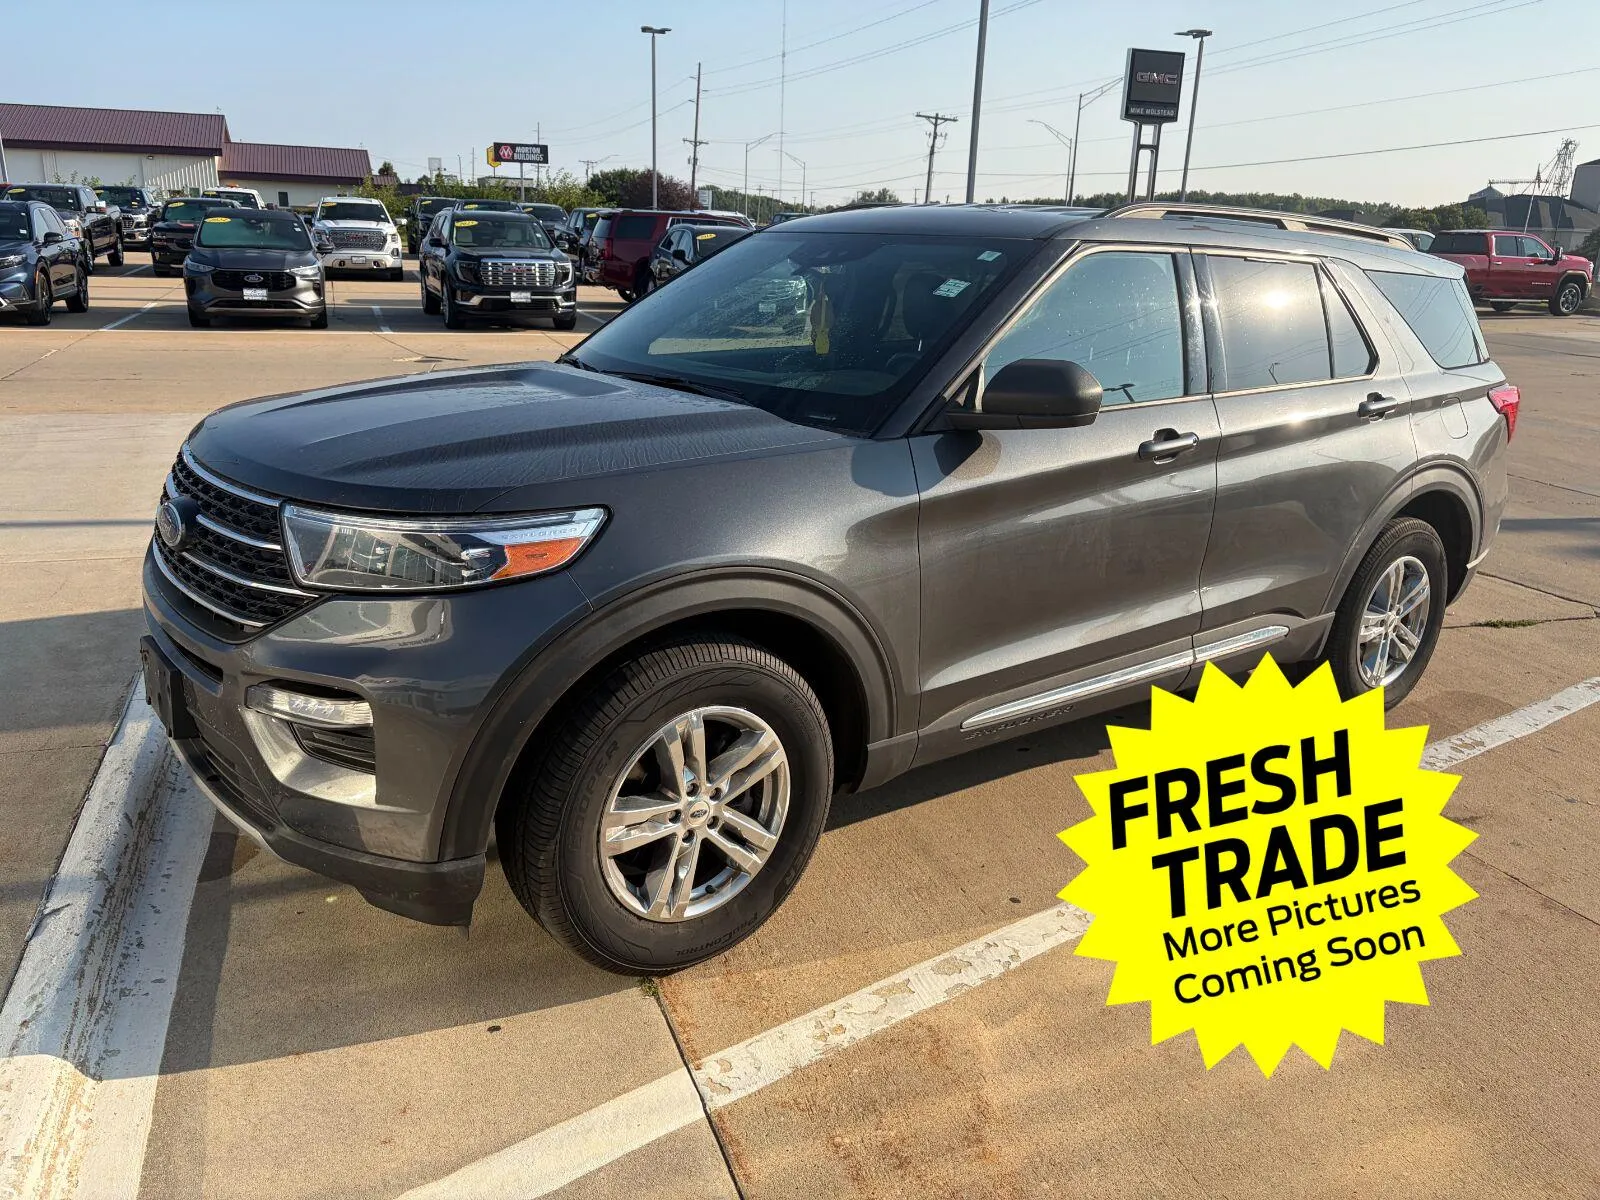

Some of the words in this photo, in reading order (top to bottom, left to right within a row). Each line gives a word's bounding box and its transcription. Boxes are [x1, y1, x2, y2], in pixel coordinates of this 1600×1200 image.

[1136, 71, 1178, 85] GMC
[1130, 107, 1145, 115] MIKE
[515, 146, 541, 154] MORTON
[514, 152, 544, 161] BUILDINGS
